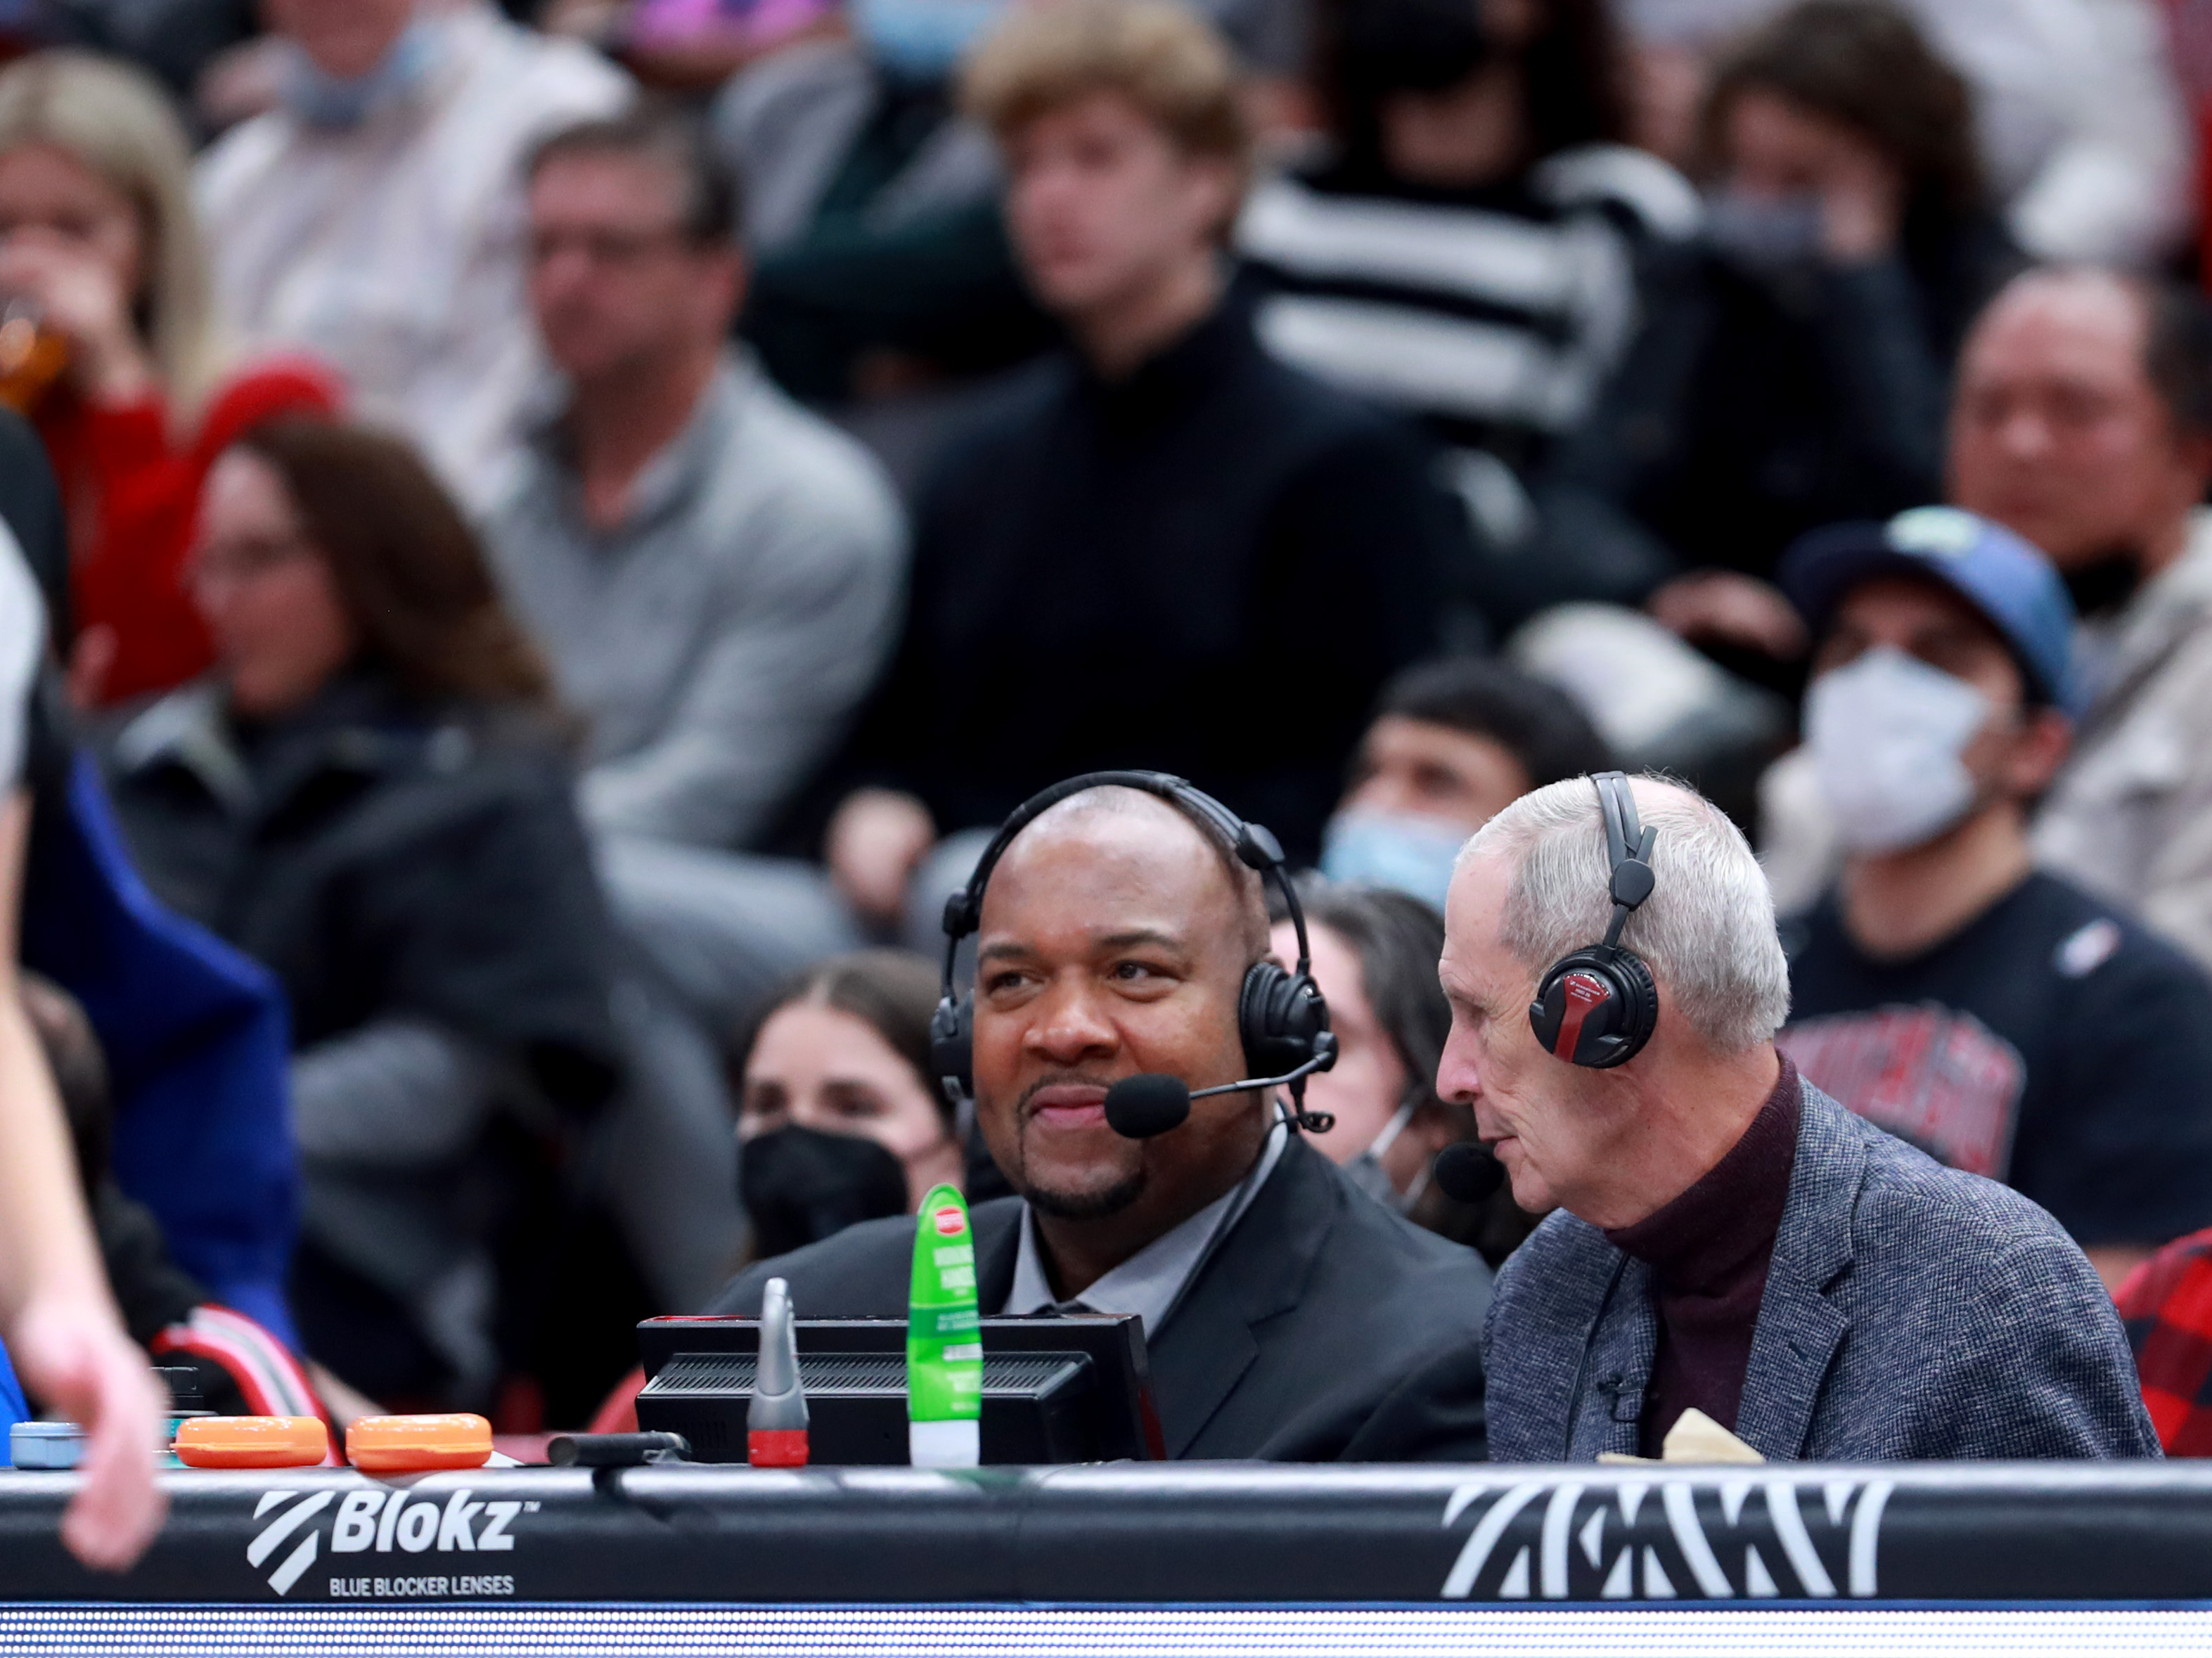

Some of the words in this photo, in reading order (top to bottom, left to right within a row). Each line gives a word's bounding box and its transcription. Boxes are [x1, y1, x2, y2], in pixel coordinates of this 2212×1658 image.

[330, 1577, 371, 1597] BLUE
[374, 1576, 449, 1596] BLOCKER
[451, 1575, 514, 1595] LENSES
